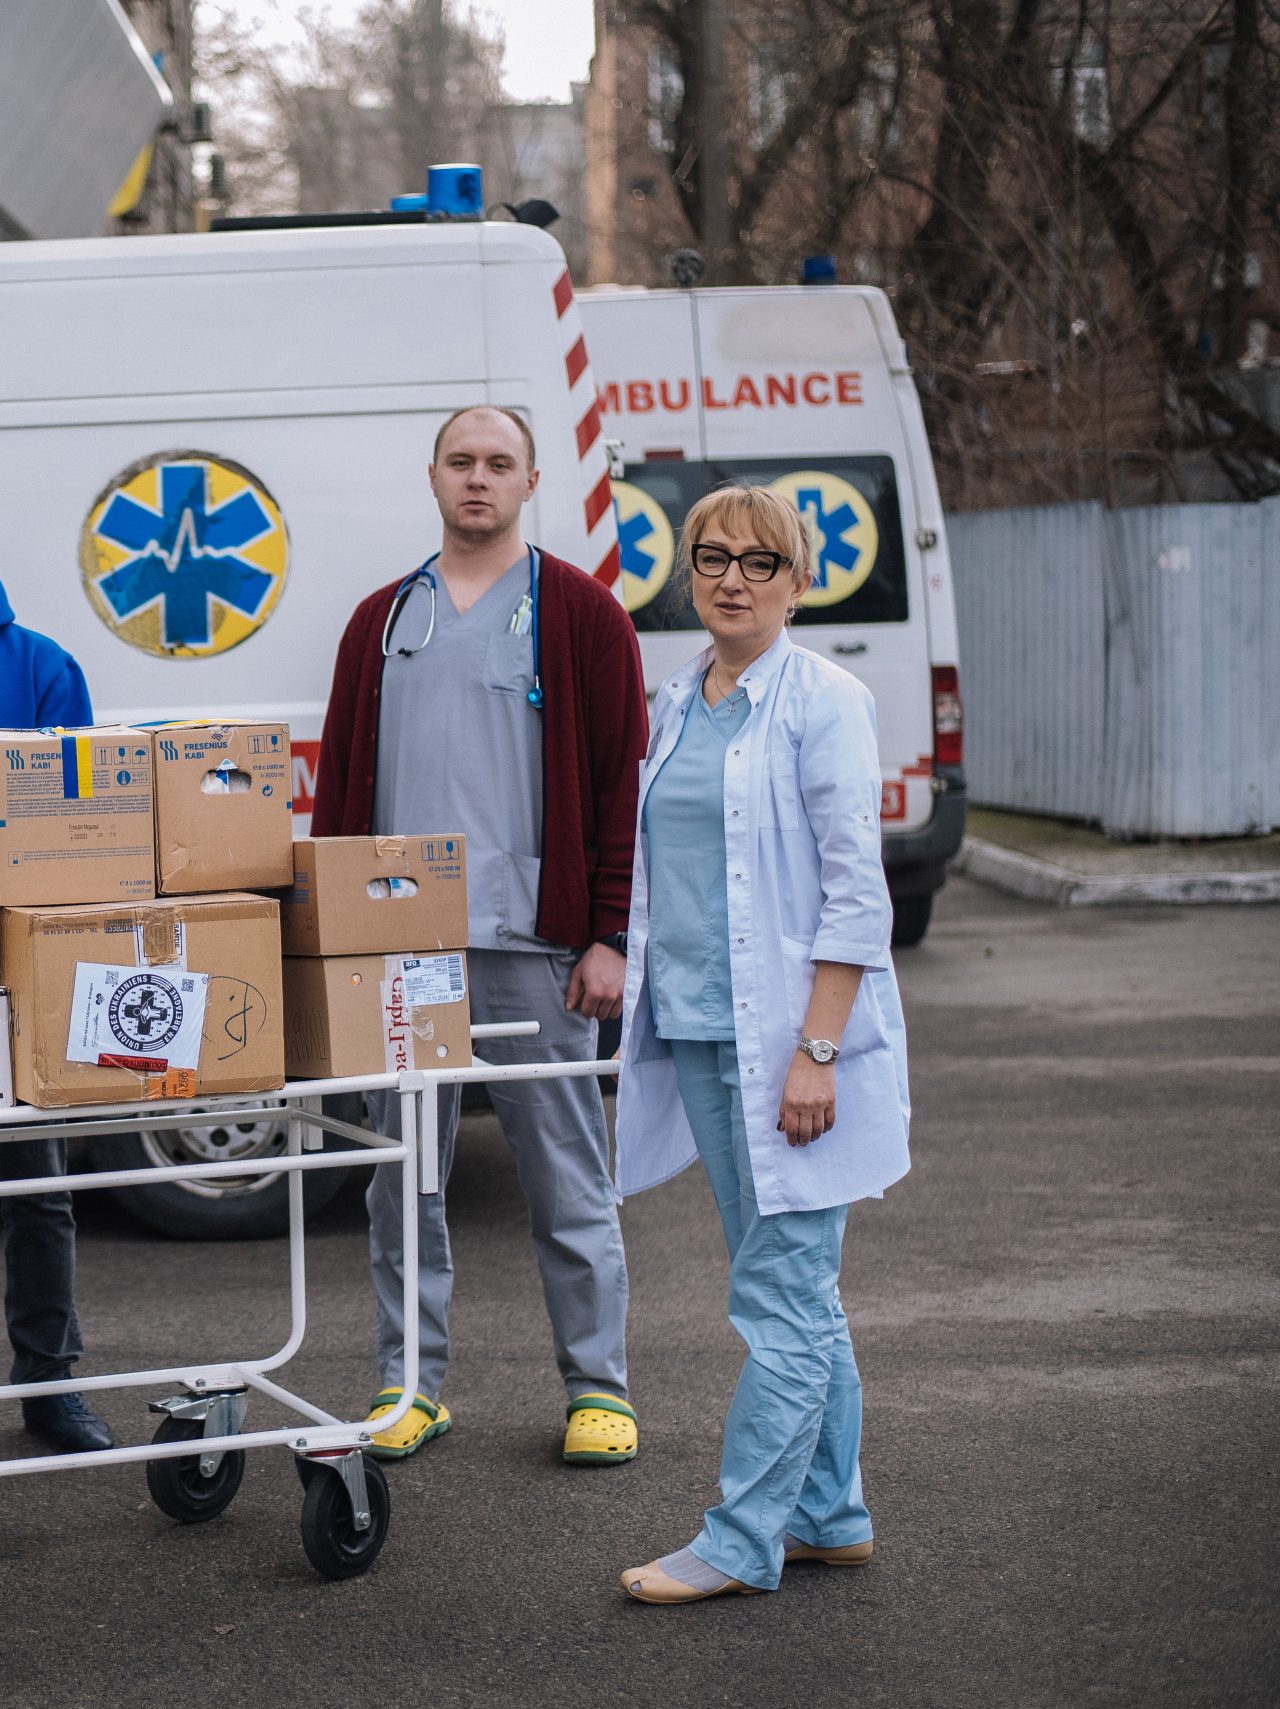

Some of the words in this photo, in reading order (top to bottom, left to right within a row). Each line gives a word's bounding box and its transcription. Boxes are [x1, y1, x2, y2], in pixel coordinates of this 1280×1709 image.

[597, 371, 864, 415] MBULANCE
[184, 741, 228, 750] FRESENIUS
[30, 752, 62, 761] FRESEN
[184, 752, 205, 760] KABI
[31, 762, 51, 770] KABI
[110, 975, 148, 1012] UKRAINIENS
[109, 1014, 121, 1031] DES
[164, 1032, 175, 1043] EN
[170, 988, 183, 1031] BRETAGNE
[117, 1031, 140, 1050] UNION
[180, 1071, 189, 1092] 0821
